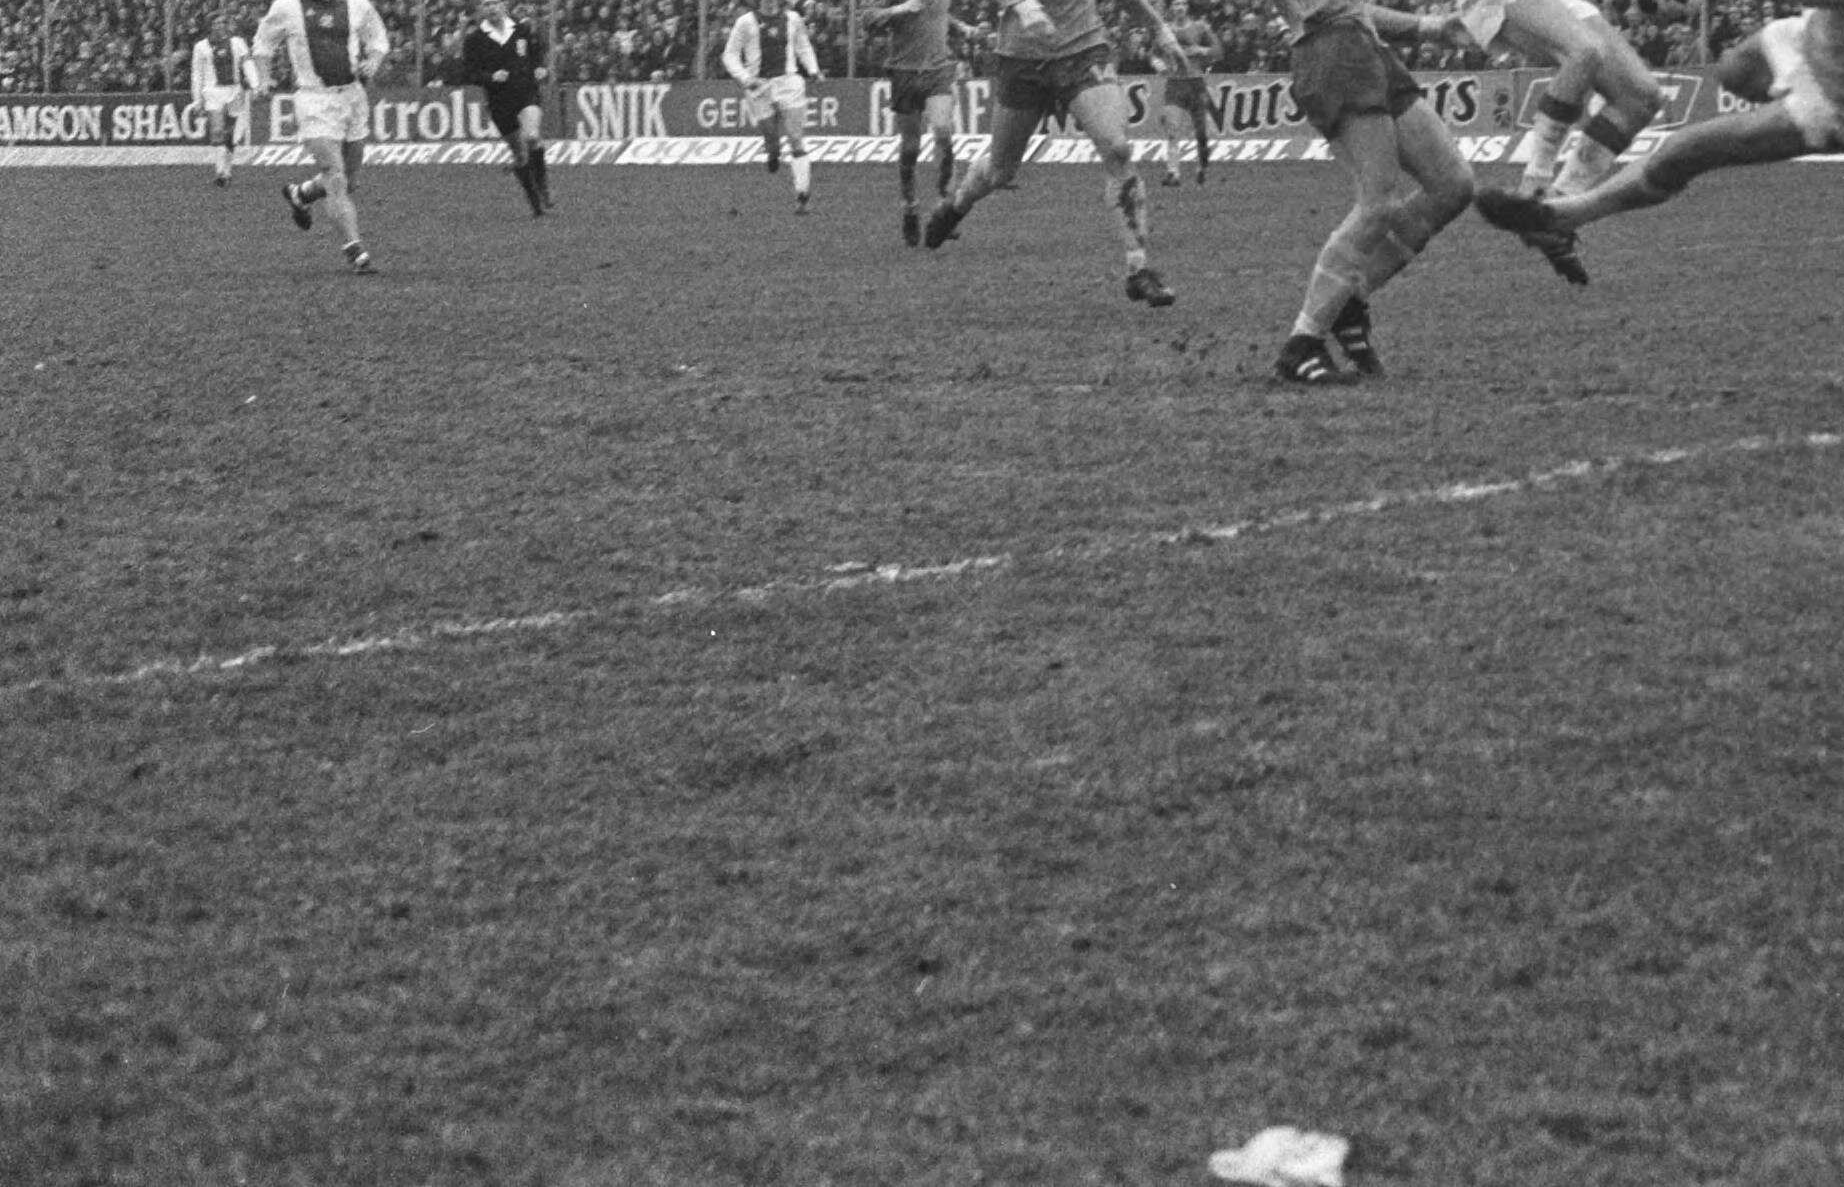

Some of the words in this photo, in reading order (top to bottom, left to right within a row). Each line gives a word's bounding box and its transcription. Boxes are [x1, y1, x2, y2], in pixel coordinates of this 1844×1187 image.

[112, 103, 207, 140] SHAG
[577, 84, 672, 140] SNIK
[697, 97, 839, 128] GENER
